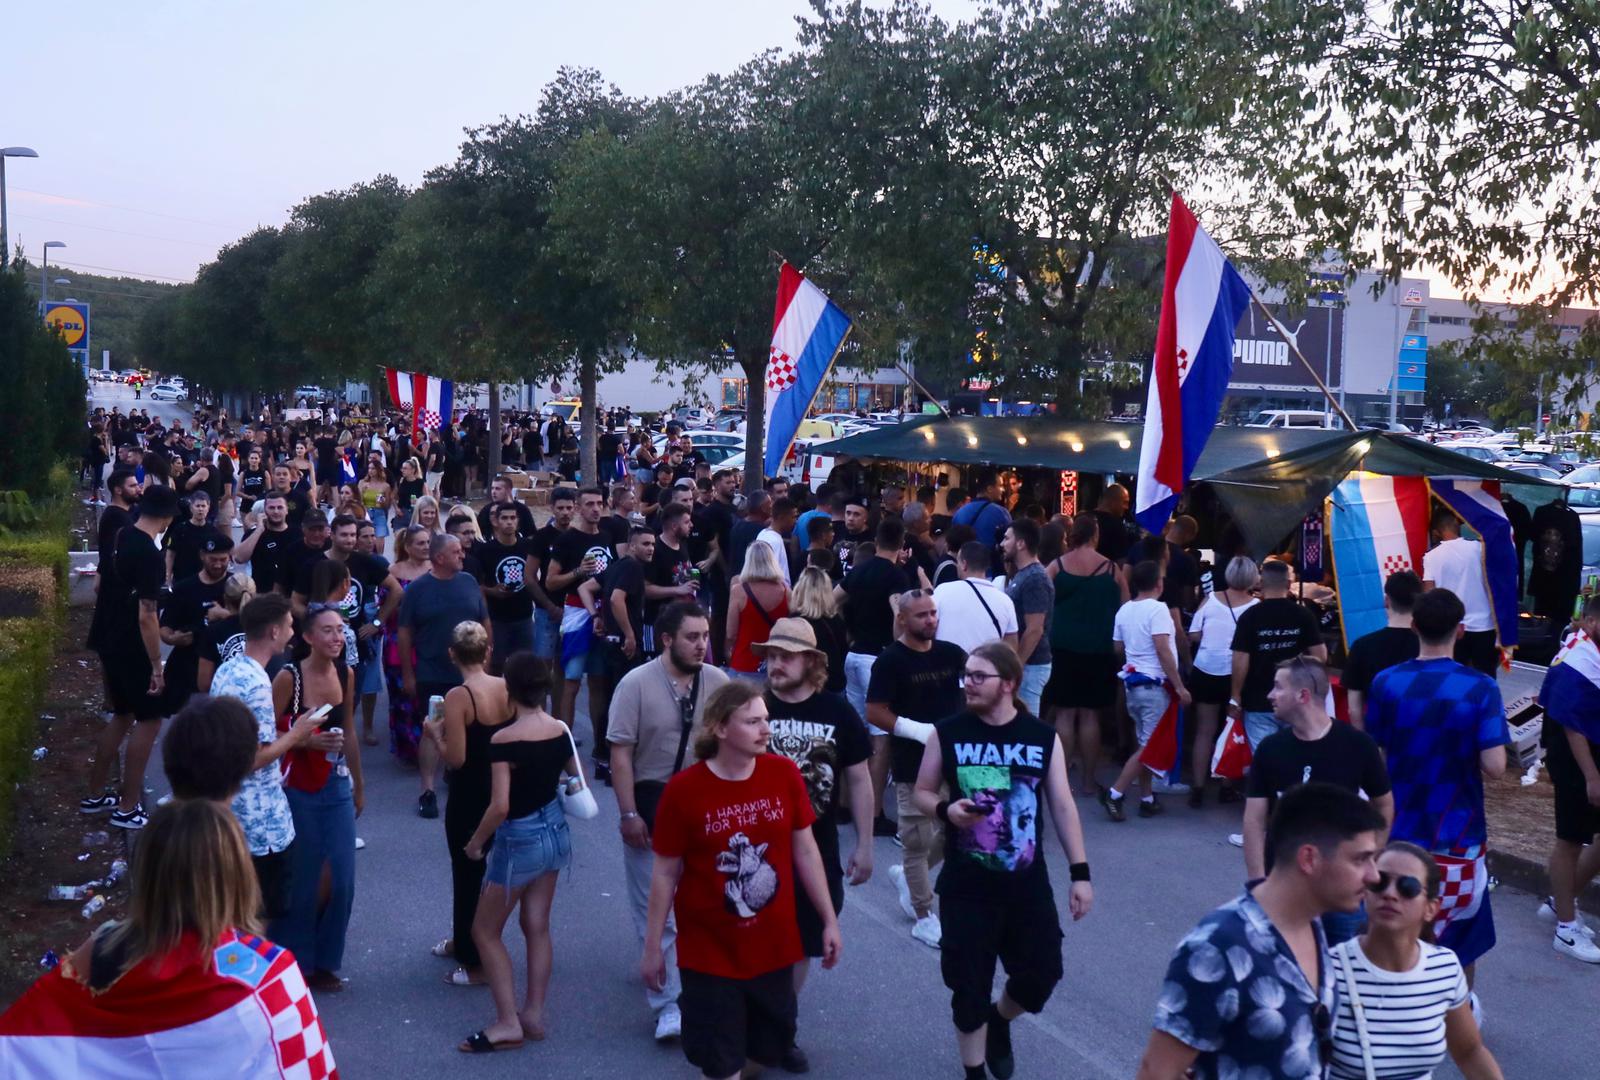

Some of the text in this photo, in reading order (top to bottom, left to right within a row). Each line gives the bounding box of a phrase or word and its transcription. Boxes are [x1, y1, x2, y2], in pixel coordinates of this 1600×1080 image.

[1232, 339, 1289, 366] PUMA
[769, 718, 836, 744] CKHARZ
[1514, 717, 1543, 737] BANA
[954, 742, 1043, 769] WAKE
[705, 807, 784, 836] FOR THE SKY
[717, 798, 771, 819] HARAKIRI
